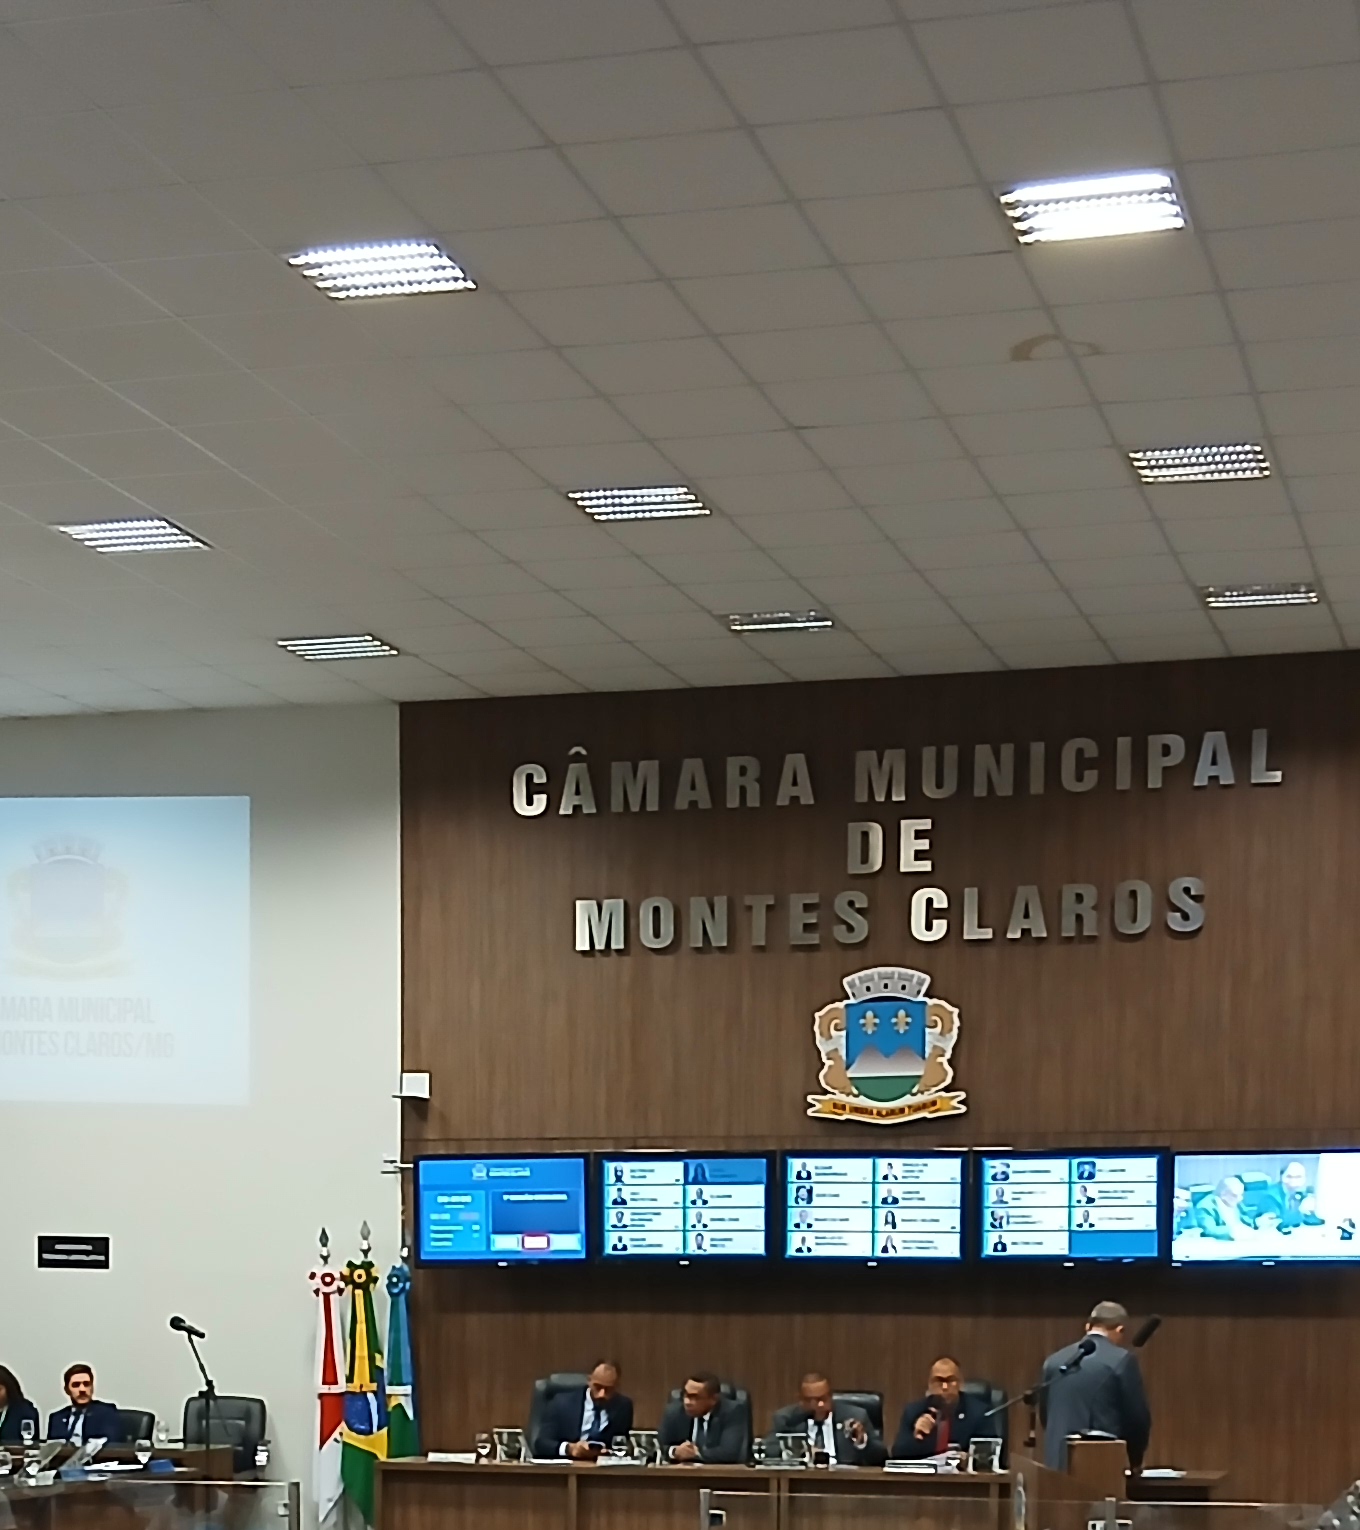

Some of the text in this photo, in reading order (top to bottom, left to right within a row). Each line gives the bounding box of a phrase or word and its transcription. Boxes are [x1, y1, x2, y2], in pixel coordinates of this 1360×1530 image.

[512, 729, 1283, 817] CÂMARA MUNICIPAL
[847, 819, 932, 875] DE
[575, 877, 1206, 951] MONTES CLAROS
[57, 997, 156, 1024] MUNICIPAL
